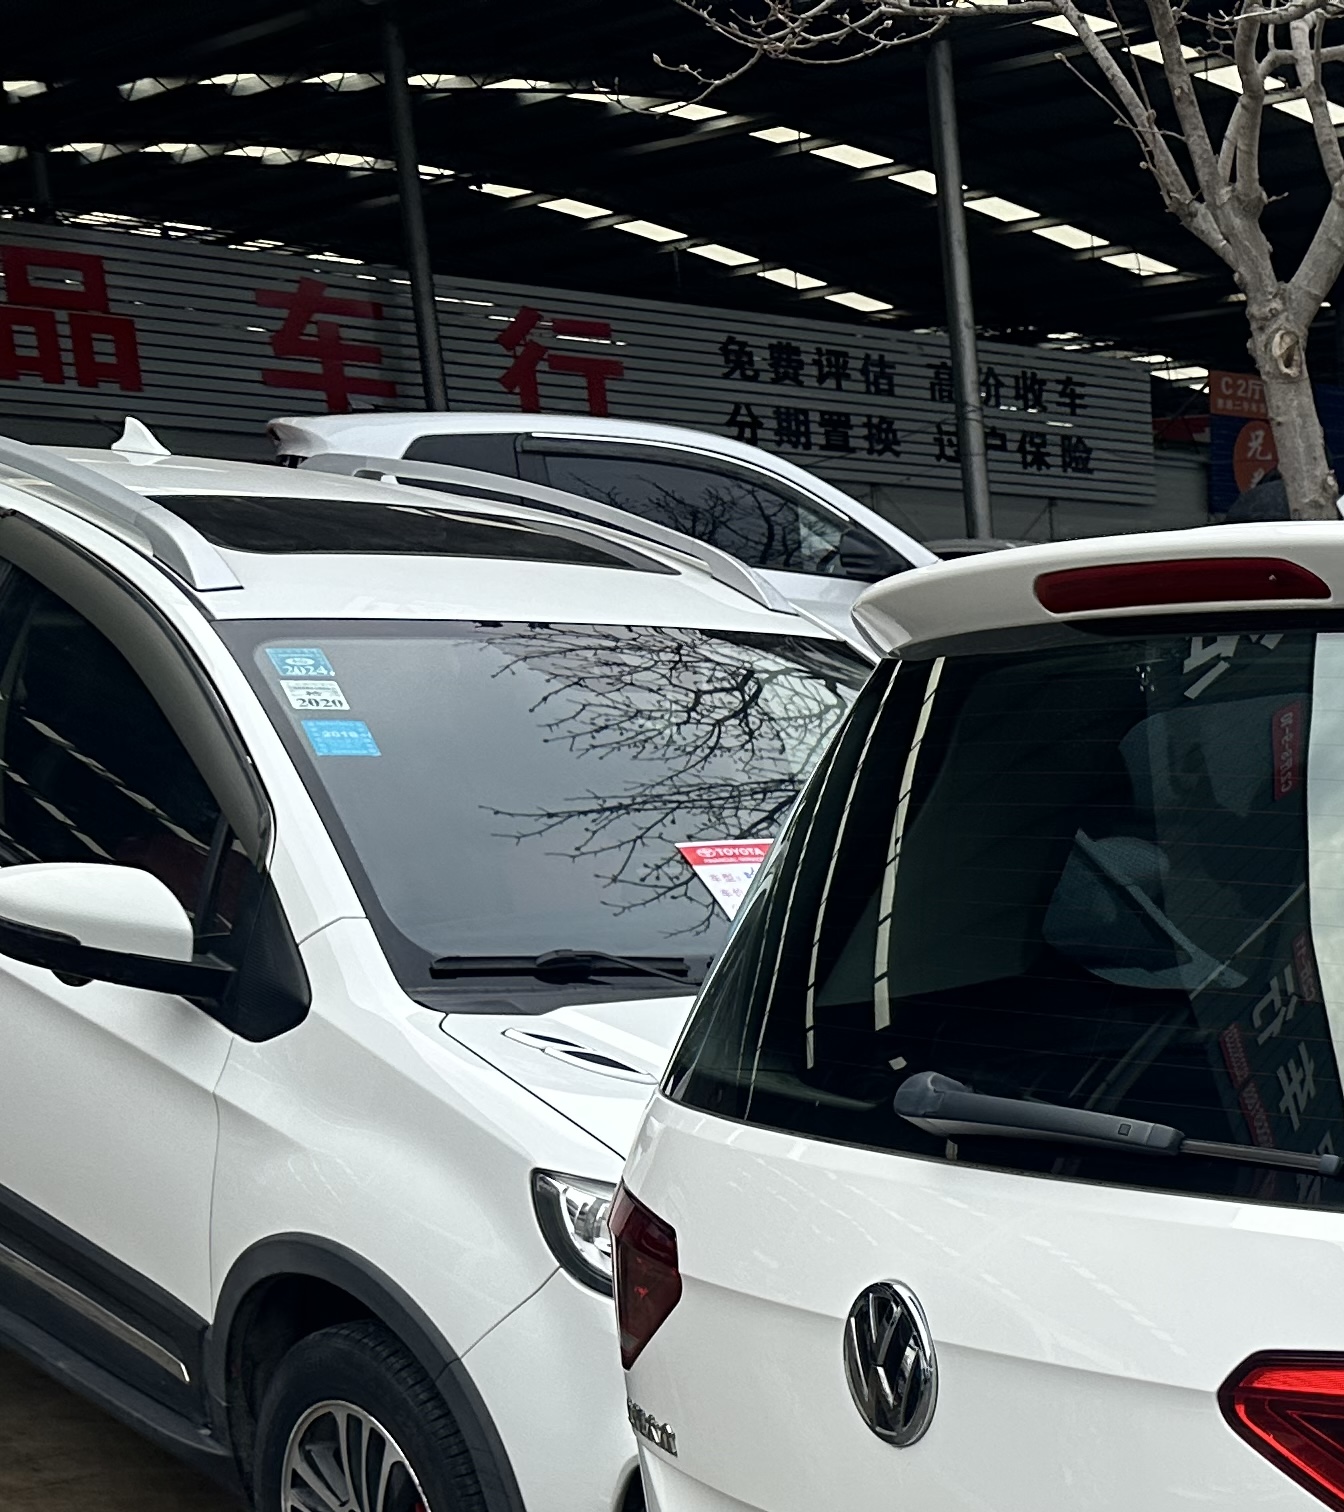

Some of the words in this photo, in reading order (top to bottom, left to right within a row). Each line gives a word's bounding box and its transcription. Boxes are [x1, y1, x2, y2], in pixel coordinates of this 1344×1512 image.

[719, 335, 896, 398] 免费评估
[725, 402, 901, 459] 分期置换
[296, 698, 344, 708] 2020
[714, 847, 765, 857] TOYOTA
